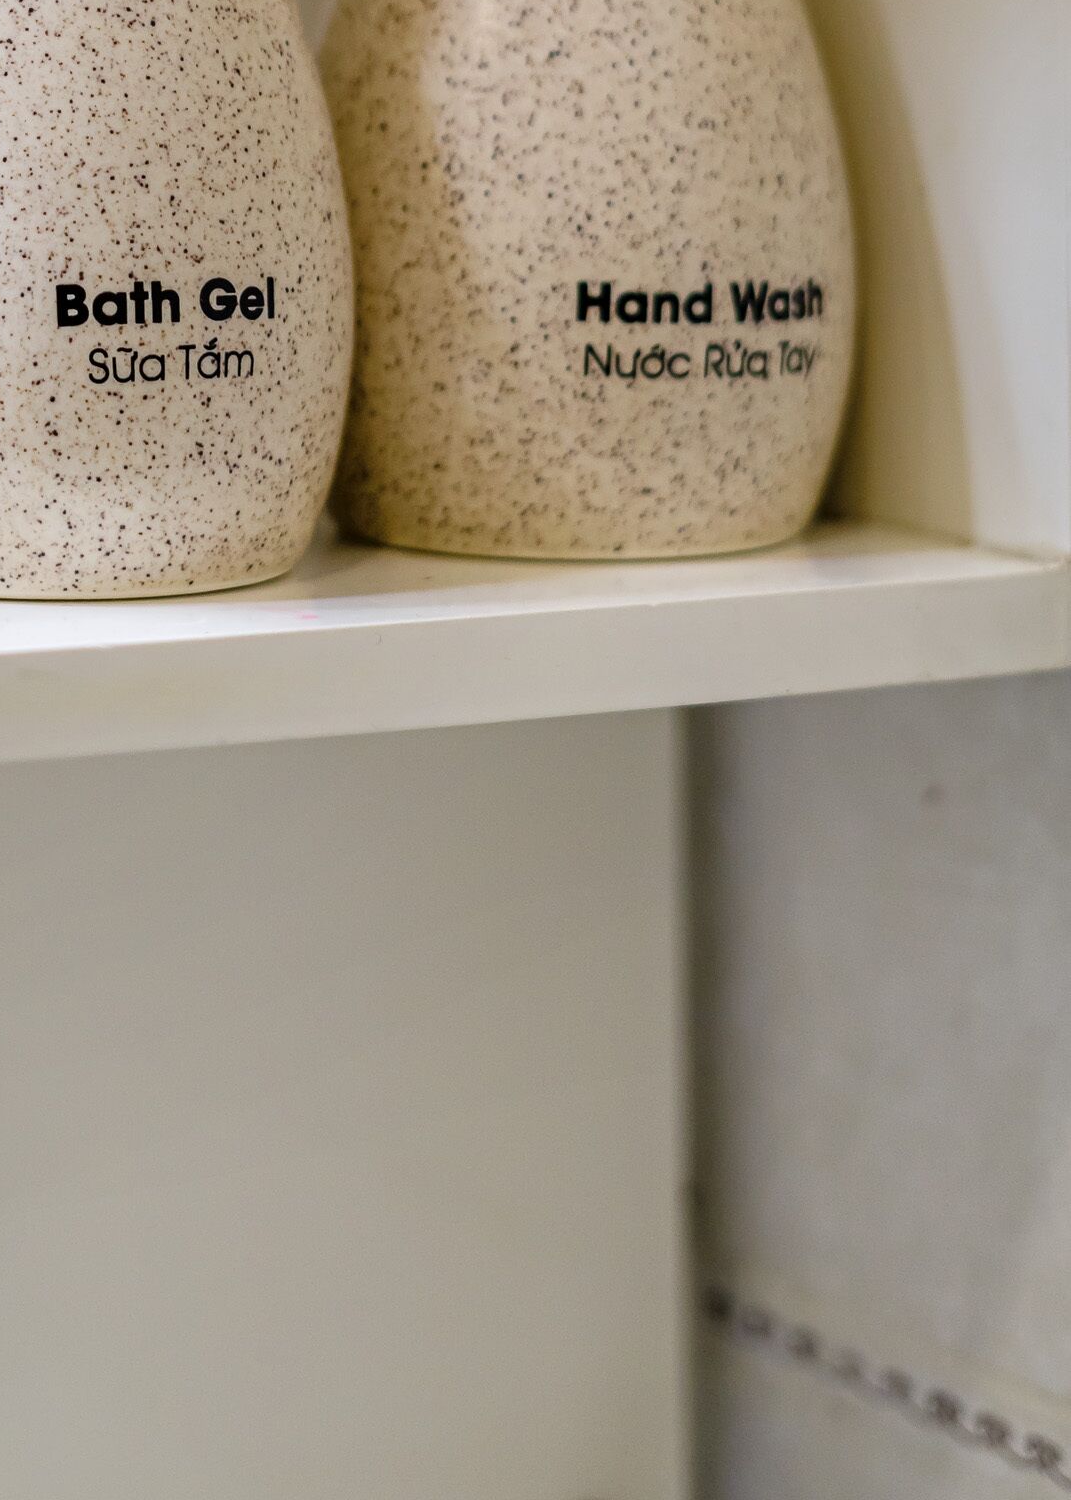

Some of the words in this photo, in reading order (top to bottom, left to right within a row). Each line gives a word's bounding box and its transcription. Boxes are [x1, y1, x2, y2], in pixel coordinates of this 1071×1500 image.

[56, 281, 181, 327] Bath
[199, 276, 276, 321] Gel
[576, 281, 714, 324] Hand
[729, 277, 824, 324] Wash
[88, 347, 166, 384] Sữa
[178, 337, 255, 380] Tắm
[583, 343, 691, 380] Nước
[703, 339, 770, 380] Rửa
[778, 340, 817, 380] Tay
